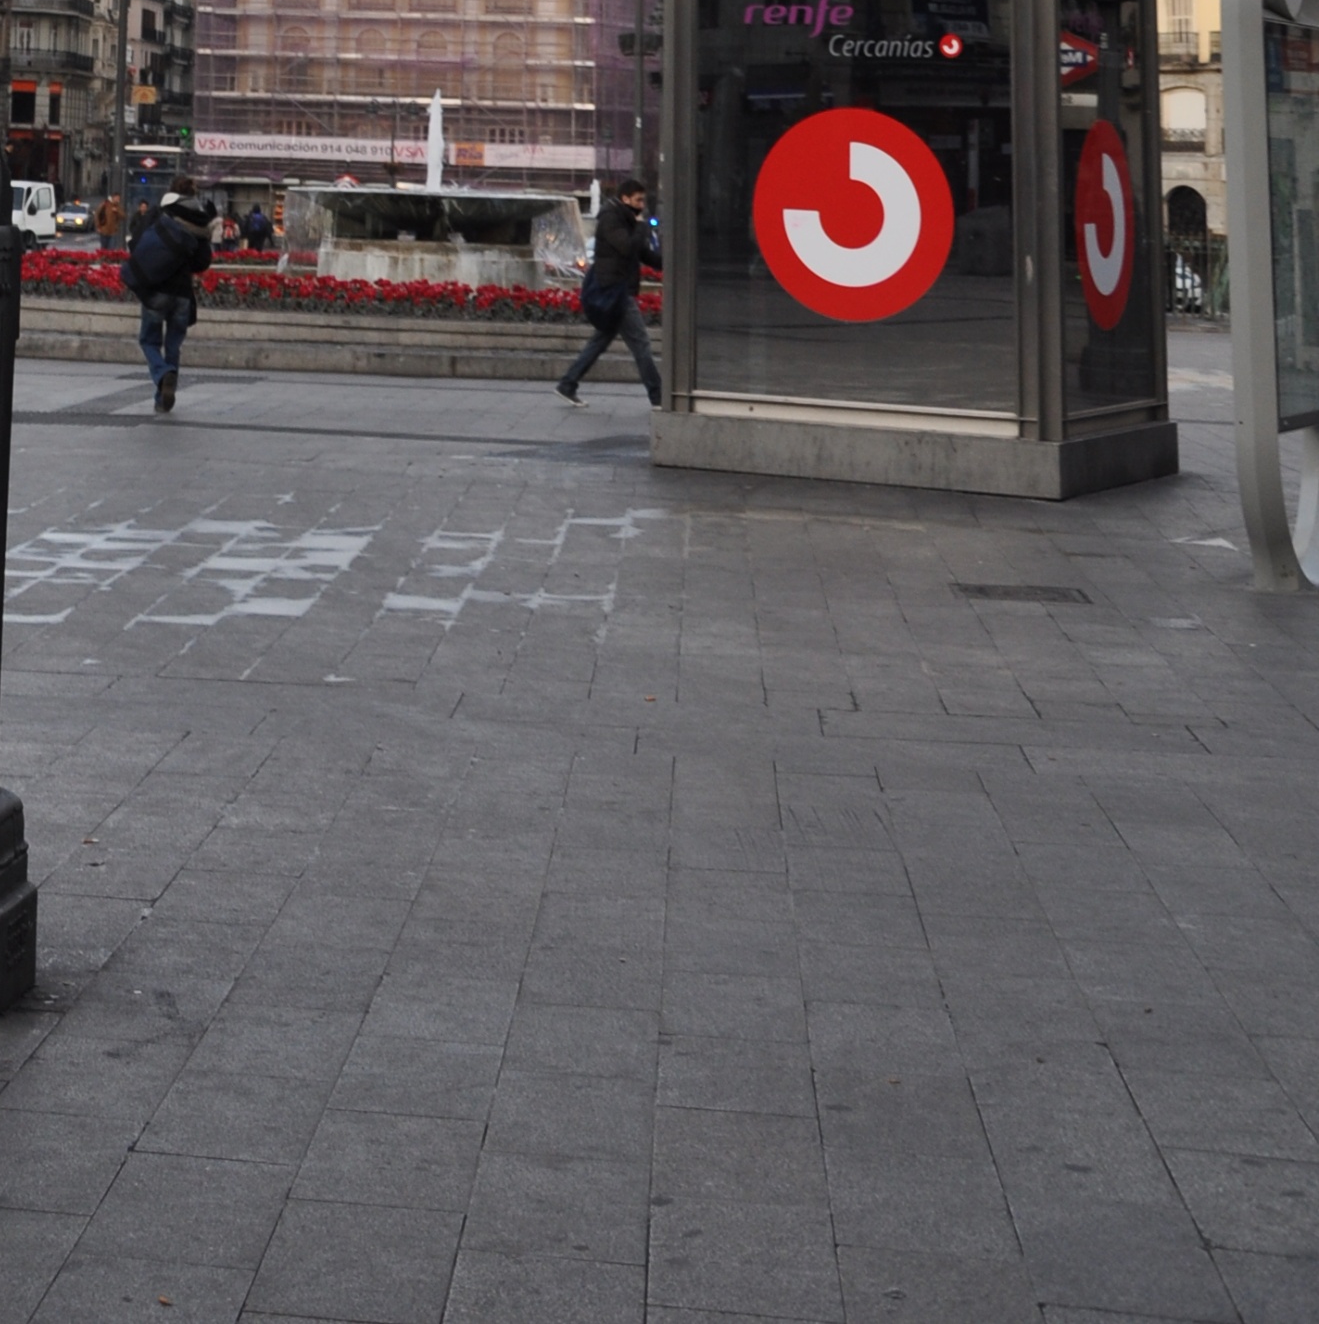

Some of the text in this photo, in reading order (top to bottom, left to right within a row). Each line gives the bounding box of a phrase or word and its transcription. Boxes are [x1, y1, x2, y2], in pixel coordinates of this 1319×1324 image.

[829, 34, 934, 58] Cercanías
[197, 137, 227, 150] VSA
[229, 139, 319, 152] comunicación
